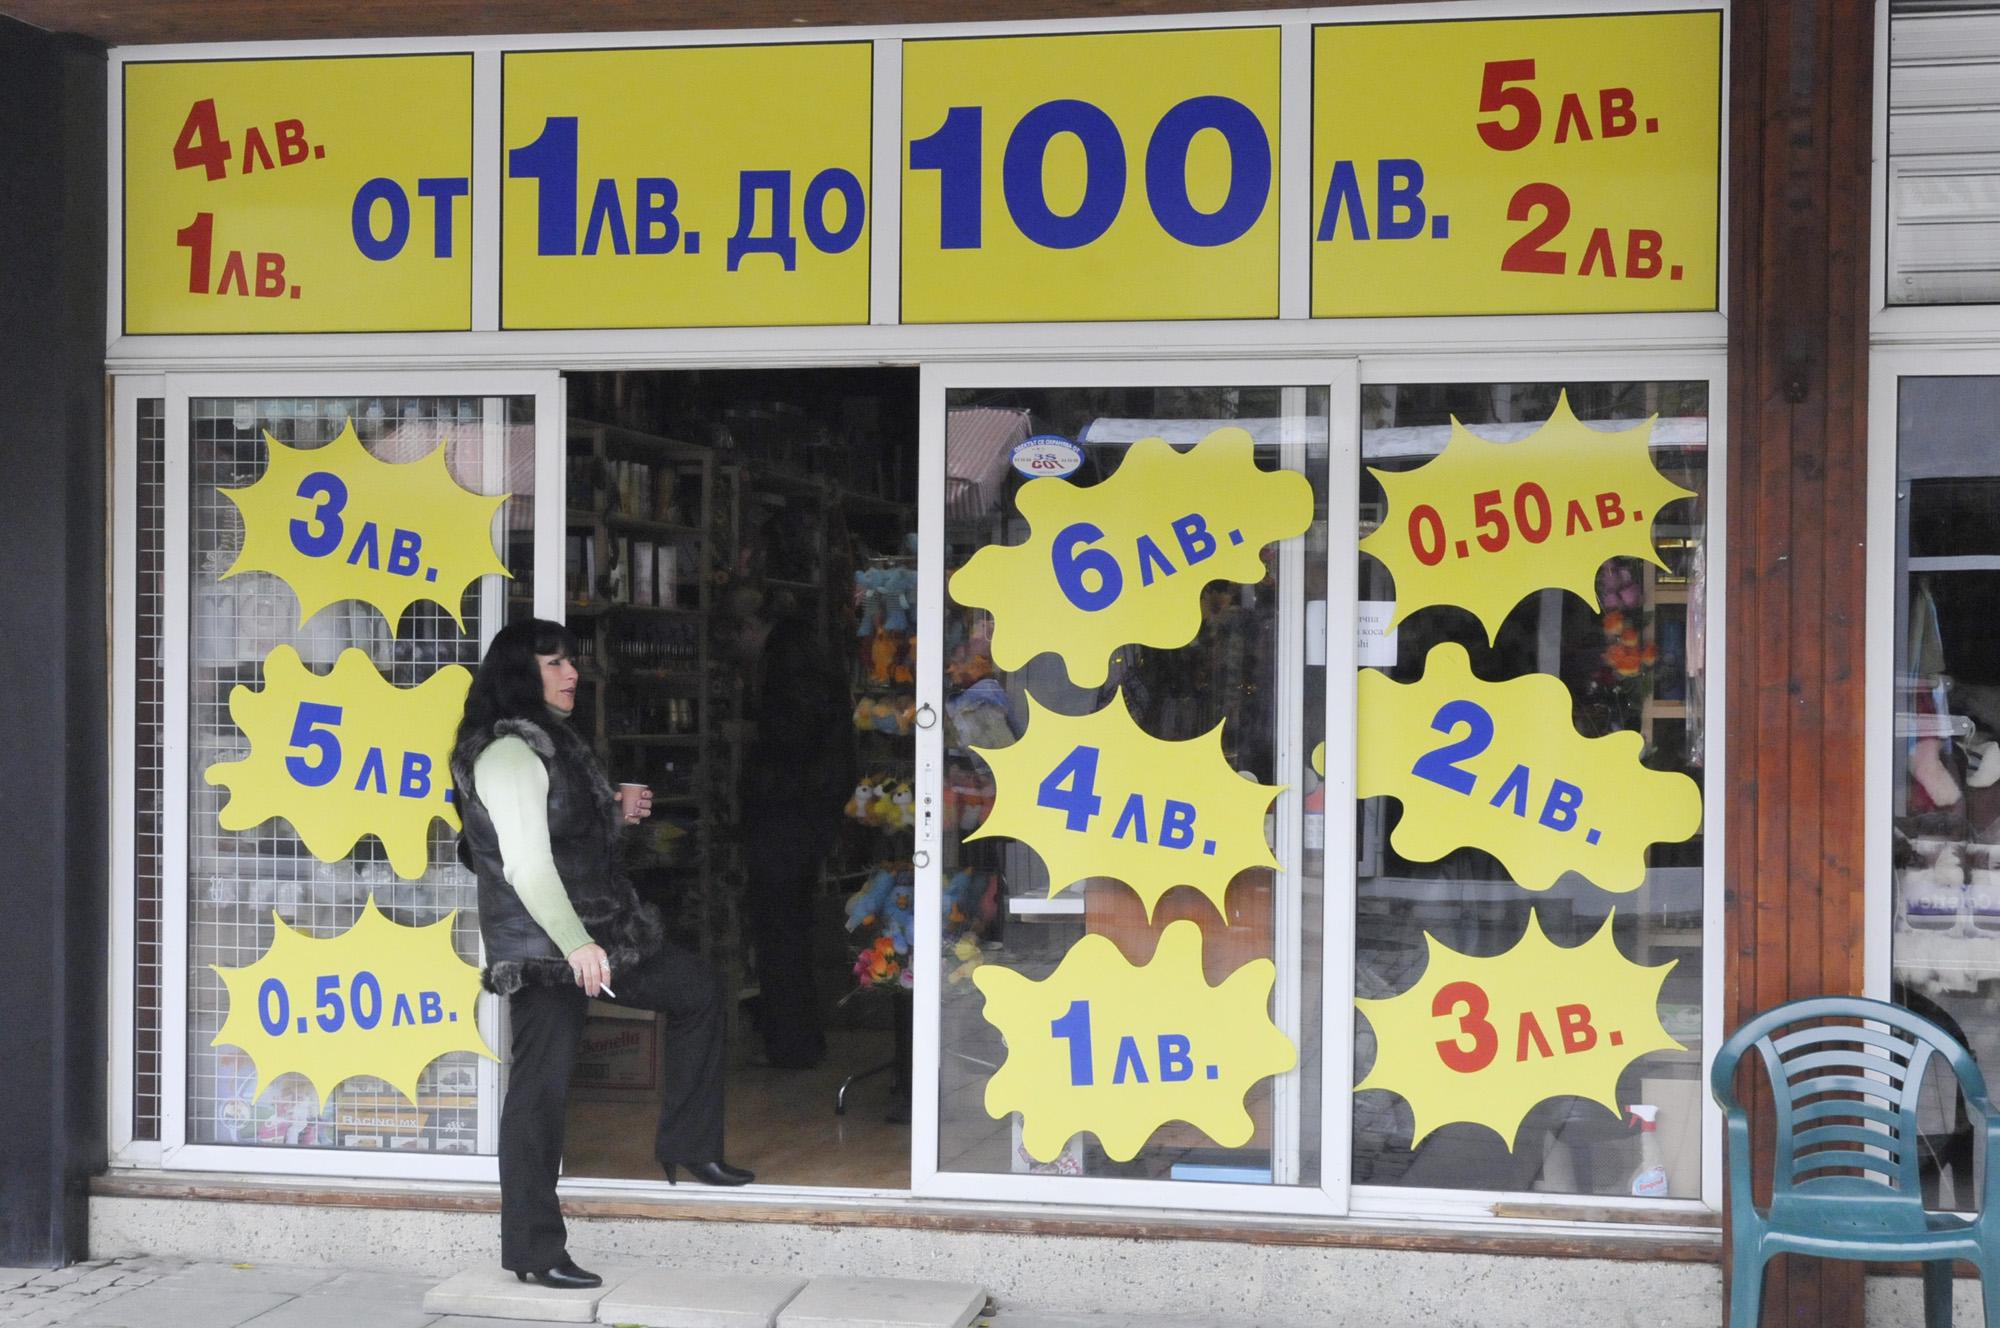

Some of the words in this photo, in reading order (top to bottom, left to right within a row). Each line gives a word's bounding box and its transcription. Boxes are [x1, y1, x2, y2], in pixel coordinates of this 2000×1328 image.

[351, 177, 469, 261] ОТ
[727, 167, 866, 272] ДО
[909, 95, 1272, 250] 100
